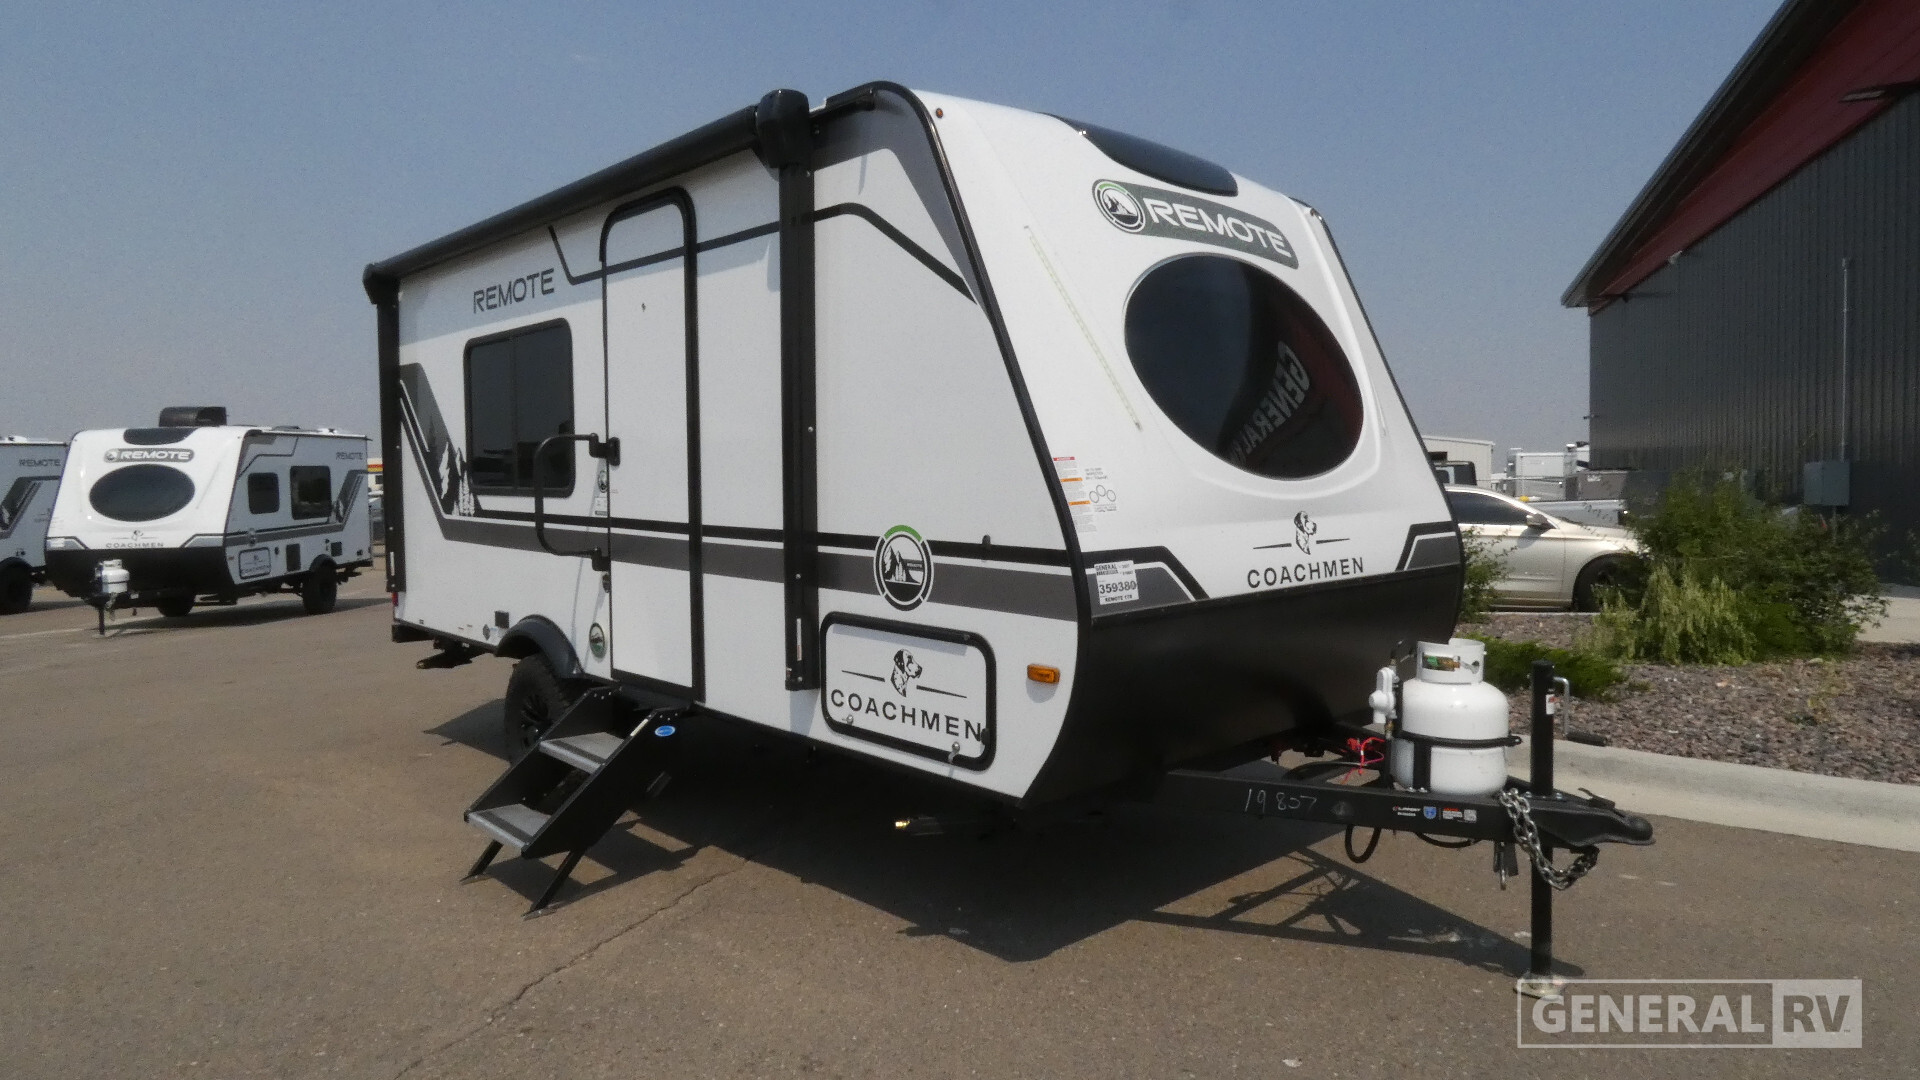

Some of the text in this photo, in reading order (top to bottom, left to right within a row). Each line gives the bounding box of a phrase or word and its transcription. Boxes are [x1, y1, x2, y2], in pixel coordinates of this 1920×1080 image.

[1143, 197, 1292, 258] REMOTE
[473, 267, 555, 314] REMOTE
[19, 459, 61, 467] REMOTE
[120, 450, 191, 460] REMOTE
[1099, 580, 1137, 594] 359380
[1247, 556, 1364, 588] COACHMEN
[831, 689, 981, 742] COACHMEN
